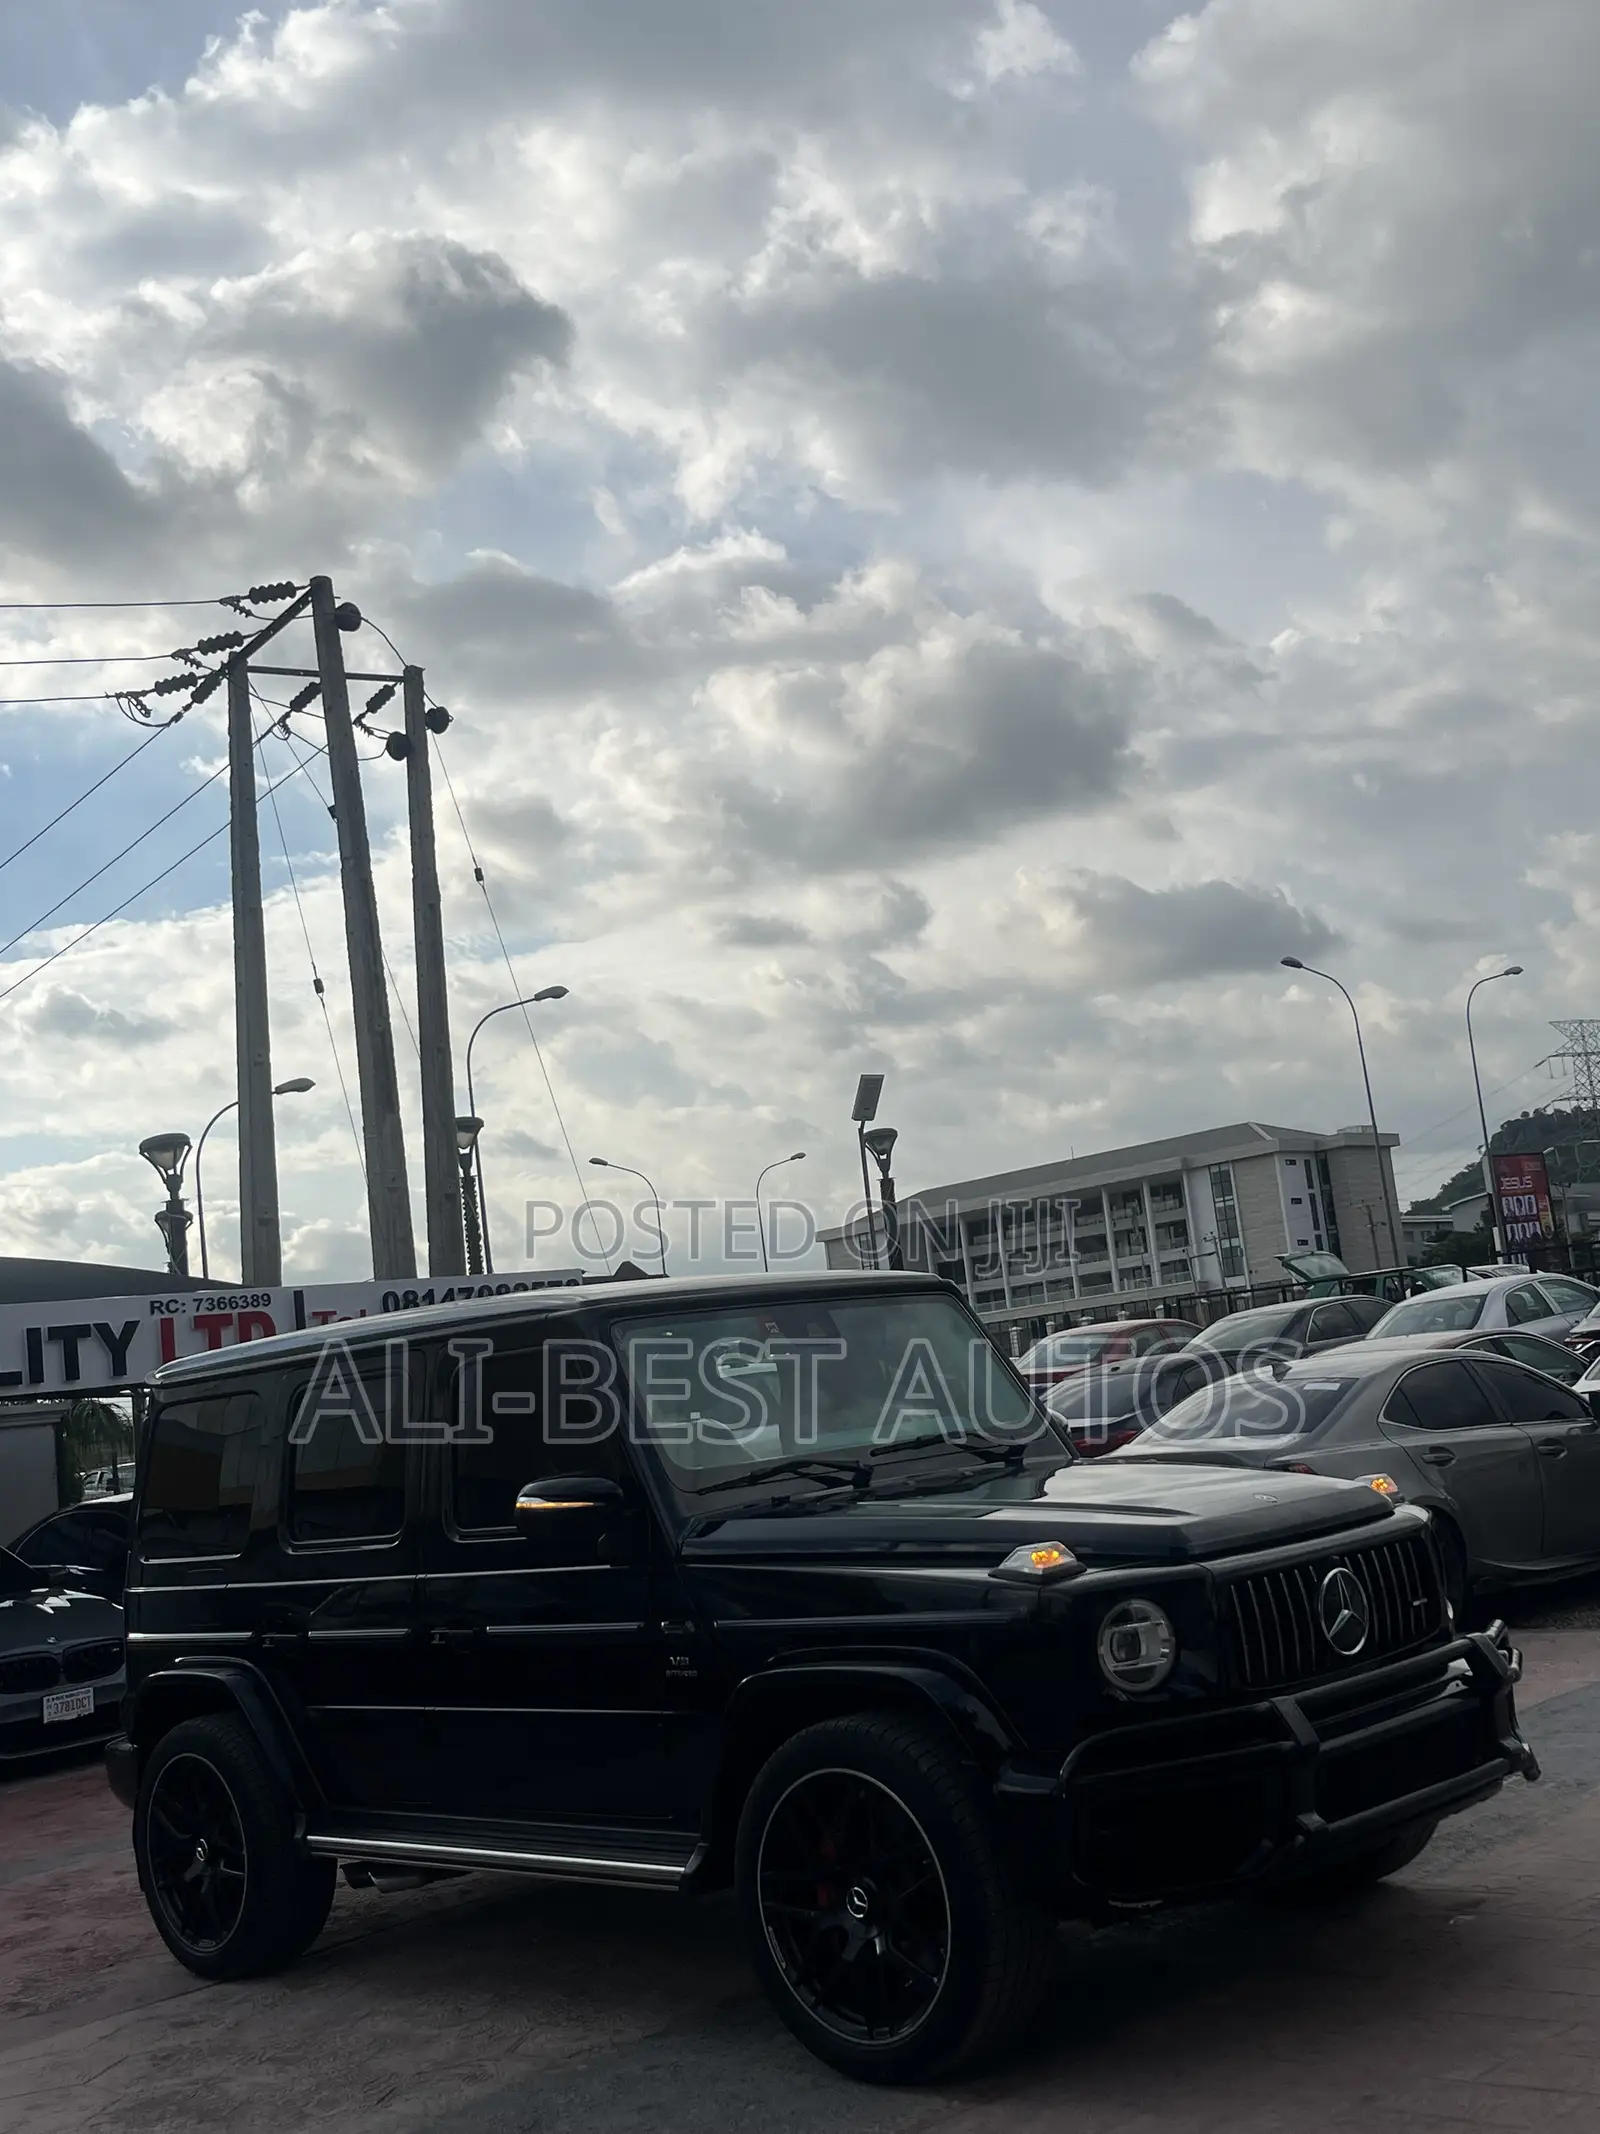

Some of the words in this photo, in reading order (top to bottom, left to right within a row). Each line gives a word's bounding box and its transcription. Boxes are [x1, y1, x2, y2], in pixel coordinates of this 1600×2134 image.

[1500, 1175, 1533, 1190] JESUS
[149, 1299, 187, 1316] RC:
[193, 1293, 272, 1313] 7366389
[0, 1319, 141, 1386] ITY
